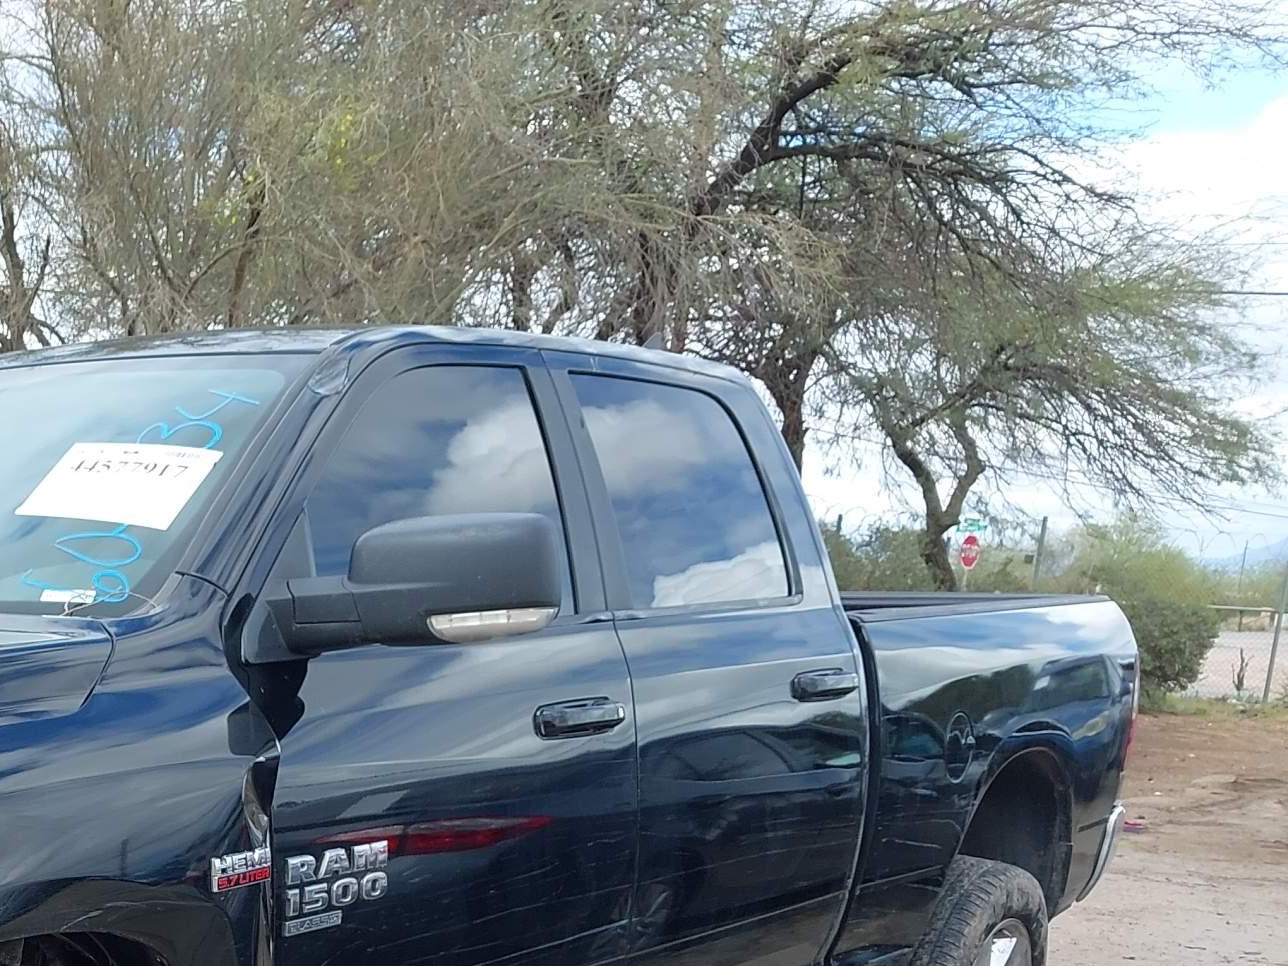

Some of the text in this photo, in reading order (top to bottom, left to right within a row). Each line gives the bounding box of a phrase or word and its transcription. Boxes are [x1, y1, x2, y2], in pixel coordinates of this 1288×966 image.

[212, 848, 271, 876] HEMI
[217, 867, 270, 890] 5.7 LITER
[285, 840, 388, 885] RAM
[285, 871, 388, 917] 1500
